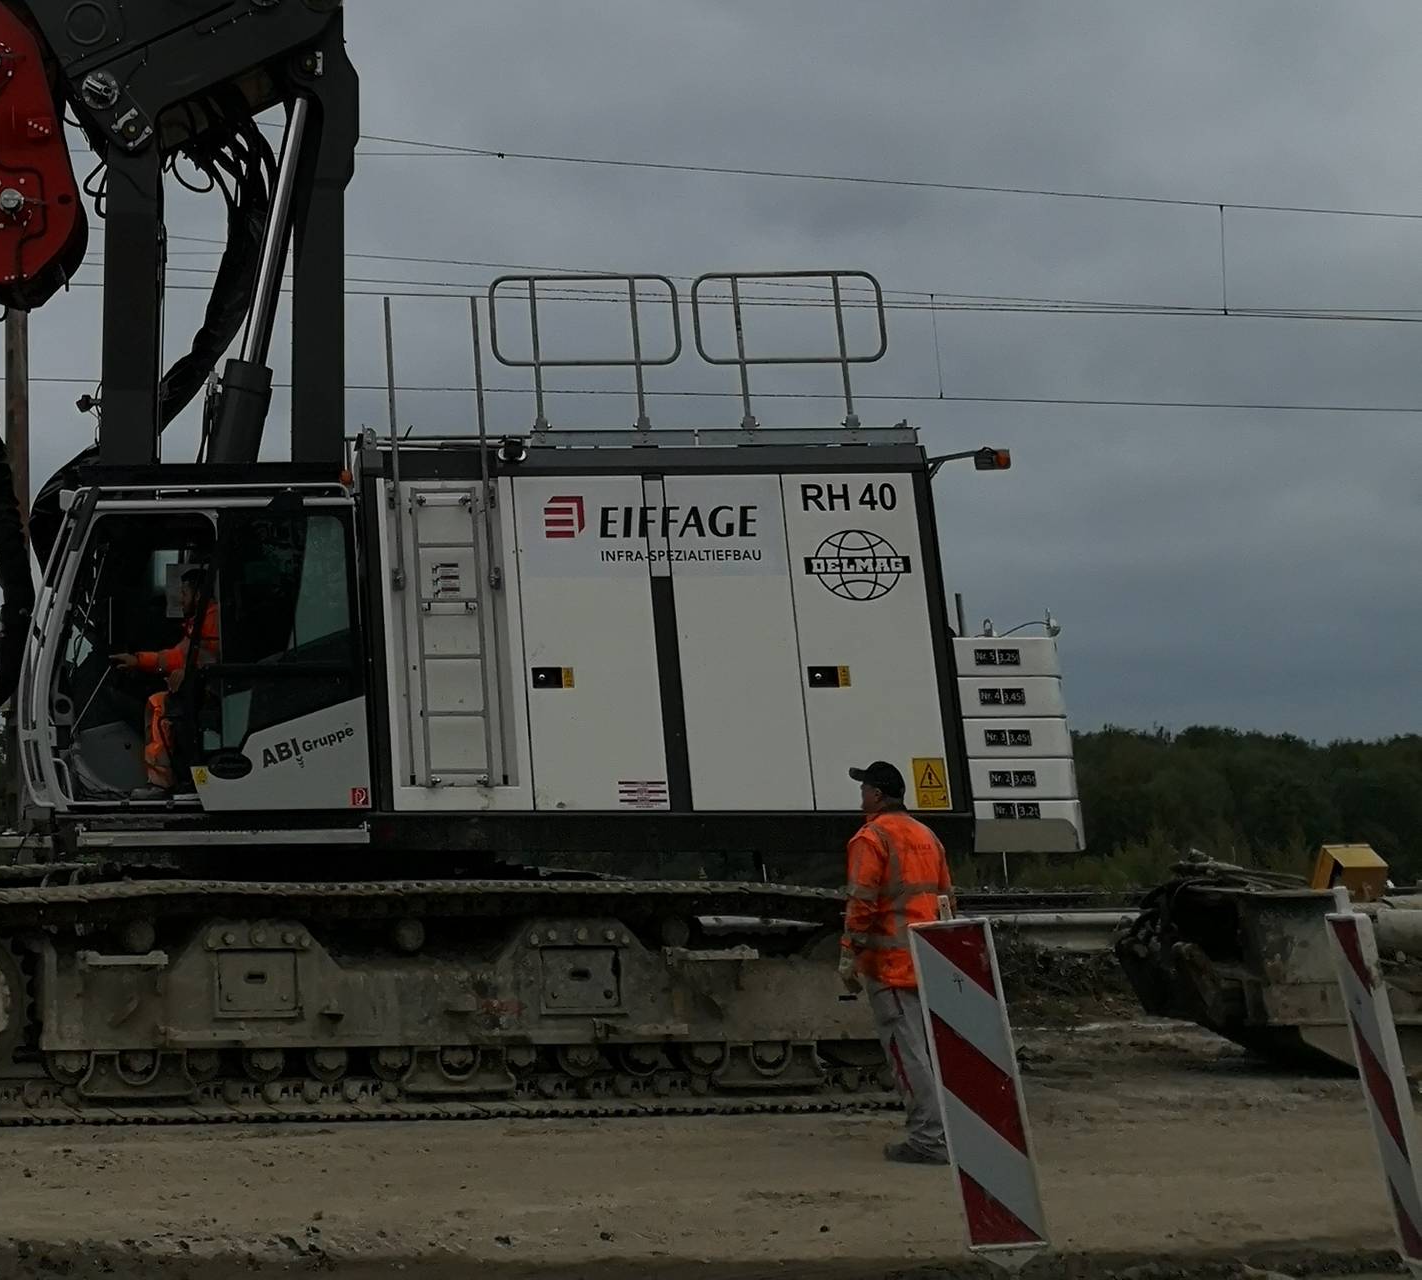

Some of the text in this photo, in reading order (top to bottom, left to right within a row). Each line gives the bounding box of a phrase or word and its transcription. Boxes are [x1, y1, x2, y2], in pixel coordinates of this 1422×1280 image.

[801, 483, 897, 511] RH 40
[599, 505, 758, 538] EIFFAGE
[600, 549, 762, 562] INFRA-SPEZIALTIEFBAU
[811, 557, 905, 574] DELMAG
[262, 726, 354, 768] ABI Gruppe
